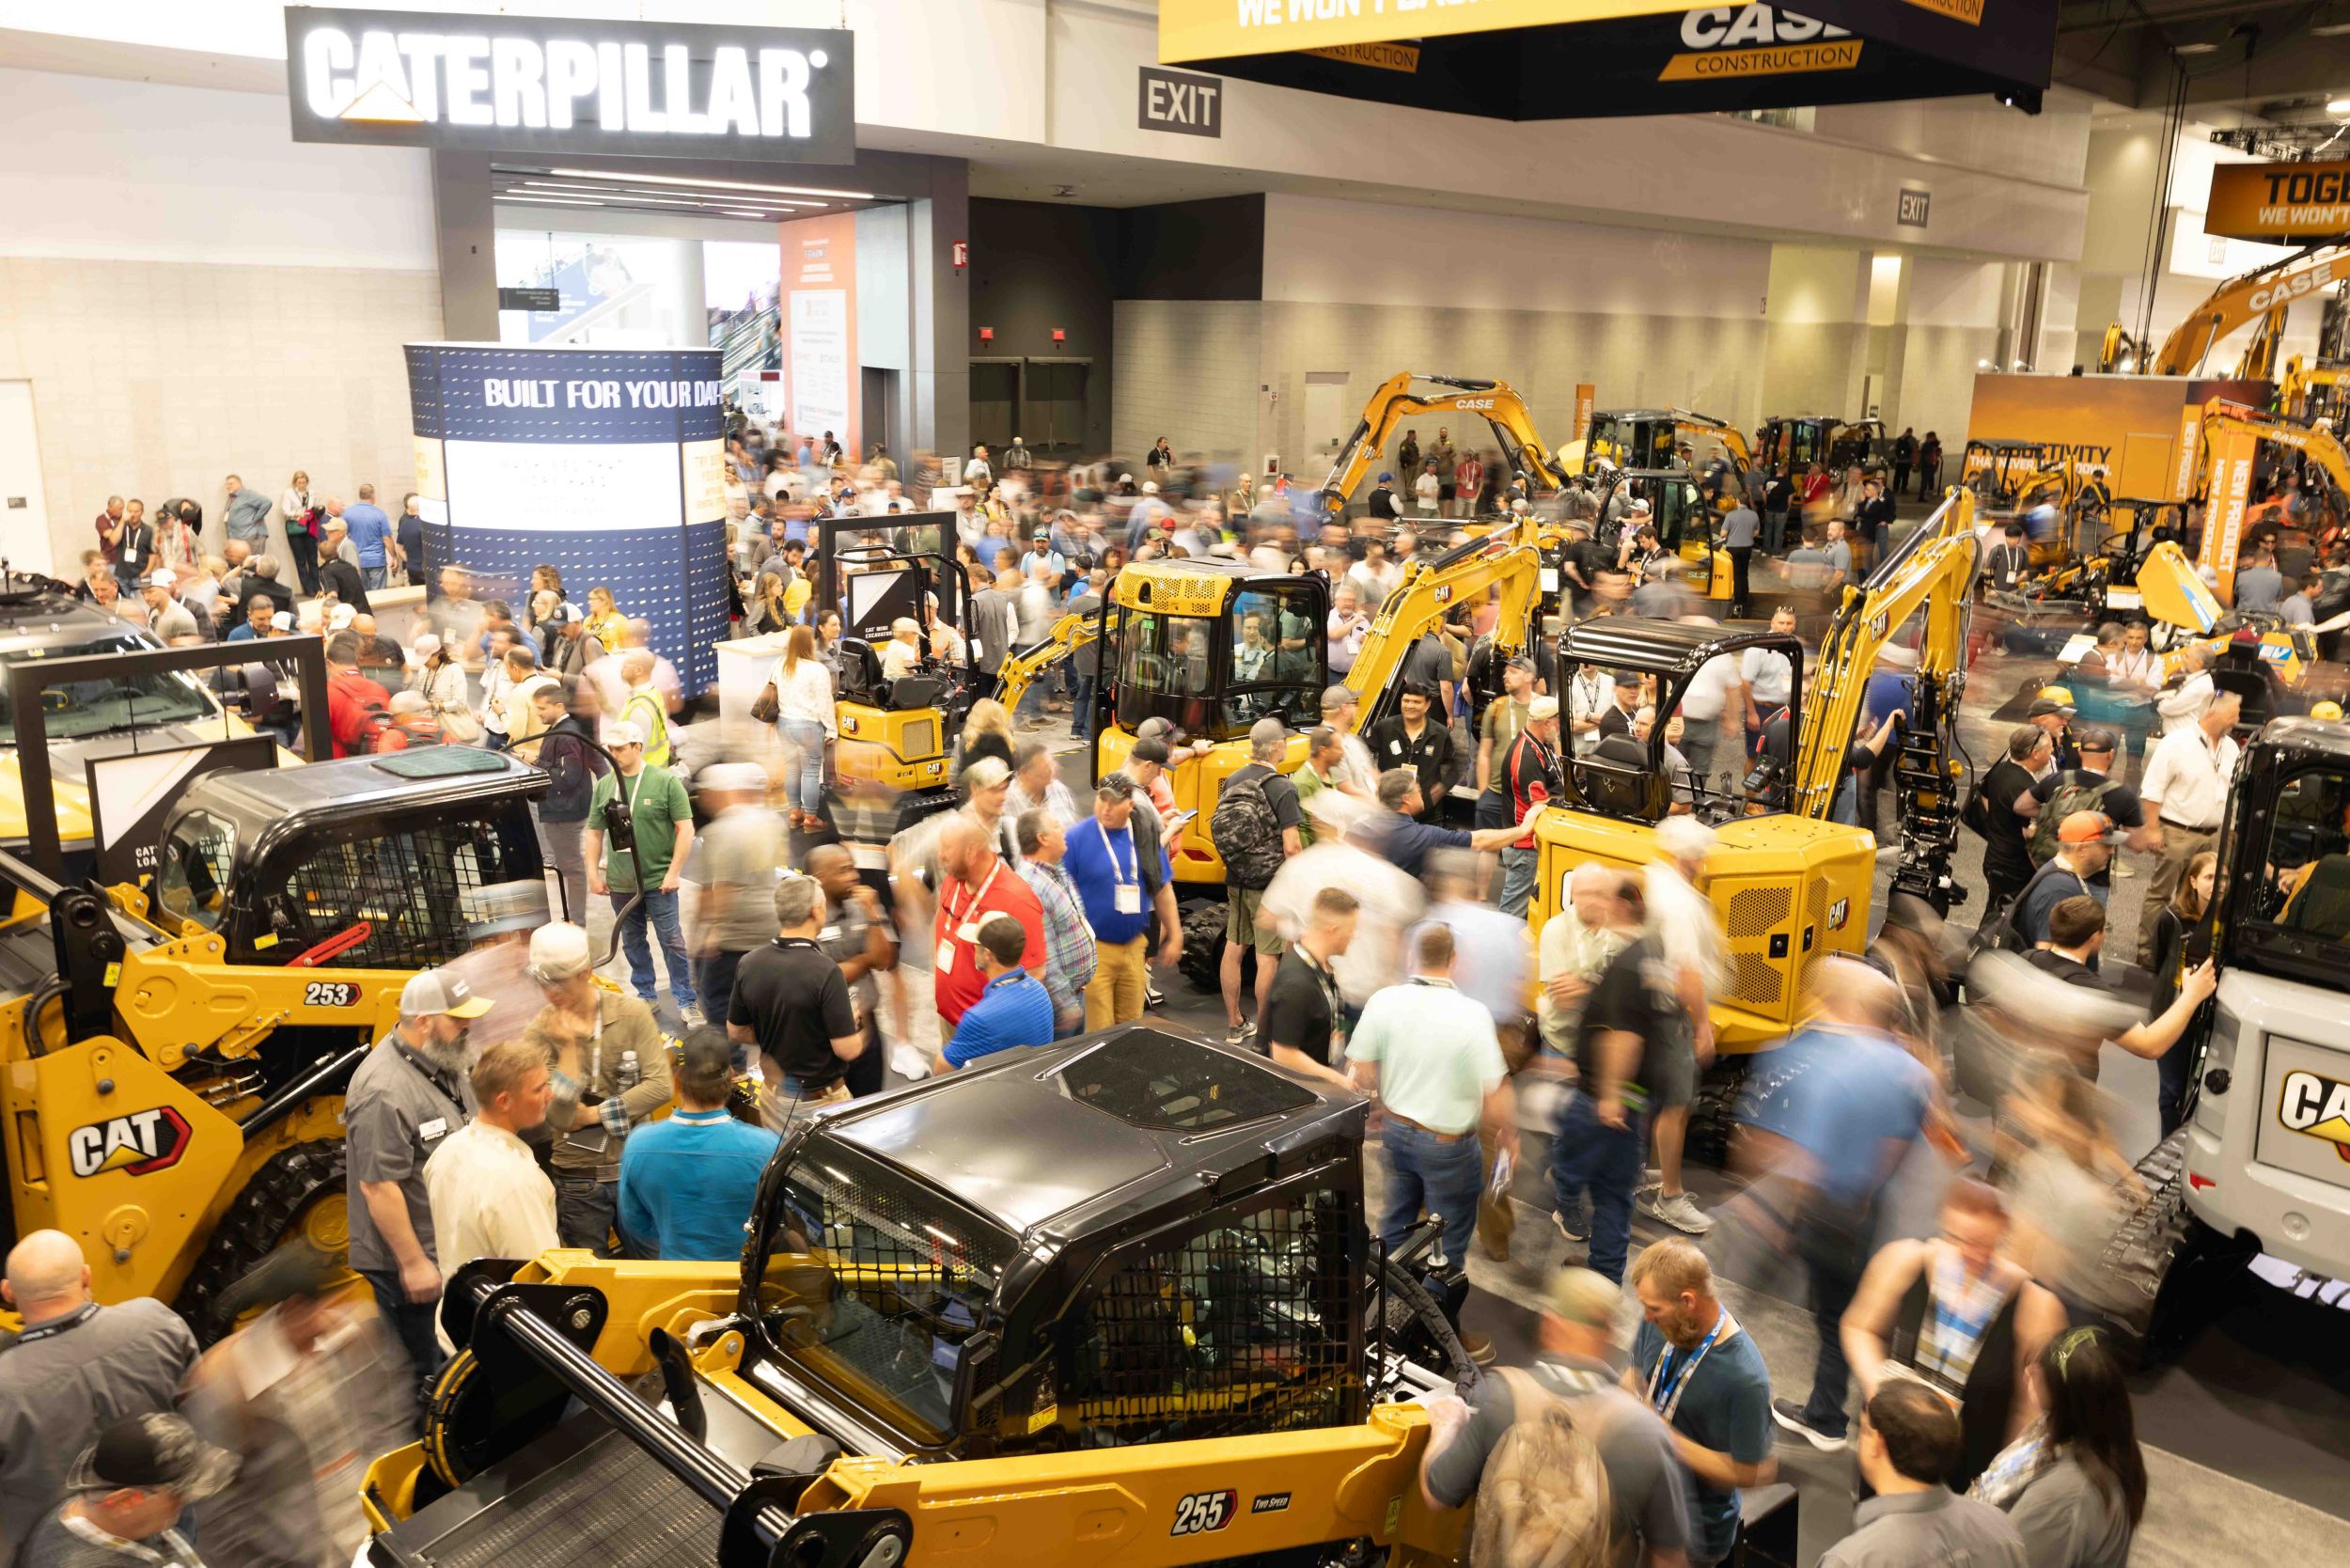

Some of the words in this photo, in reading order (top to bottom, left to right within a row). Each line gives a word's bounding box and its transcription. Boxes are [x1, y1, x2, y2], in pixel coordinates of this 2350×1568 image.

[1237, 0, 1282, 27] WE
[1288, 0, 1385, 23] WON
[1680, 2, 1852, 49] CAS
[1316, 43, 1414, 69] NSTRUCTION
[1695, 47, 1854, 75] CONSTRUCTION
[304, 28, 811, 137] CATERPILLAR
[1148, 79, 1217, 126] EXIT
[1901, 195, 1928, 222] EXIT
[2259, 207, 2288, 226] WE
[2291, 205, 2350, 226] WON'T
[2248, 262, 2332, 313] CASE
[484, 378, 559, 408] BUILT
[567, 380, 621, 409] FOR
[625, 380, 692, 409] YOUR
[1456, 399, 1495, 410] CASE
[2271, 431, 2308, 446] CASE
[1969, 454, 1998, 467] THA
[2212, 459, 2226, 495] NEW
[2230, 460, 2249, 497] NEW
[2218, 500, 2243, 573] PRODUCT
[1434, 585, 1449, 603] CAT
[1871, 611, 1888, 641] CAT
[842, 715, 855, 731] CAT
[927, 762, 941, 775] CAT
[1828, 899, 1847, 930] CAT
[305, 981, 349, 1006] 253
[70, 1108, 162, 1177] CAT
[1171, 1492, 1227, 1534] 255
